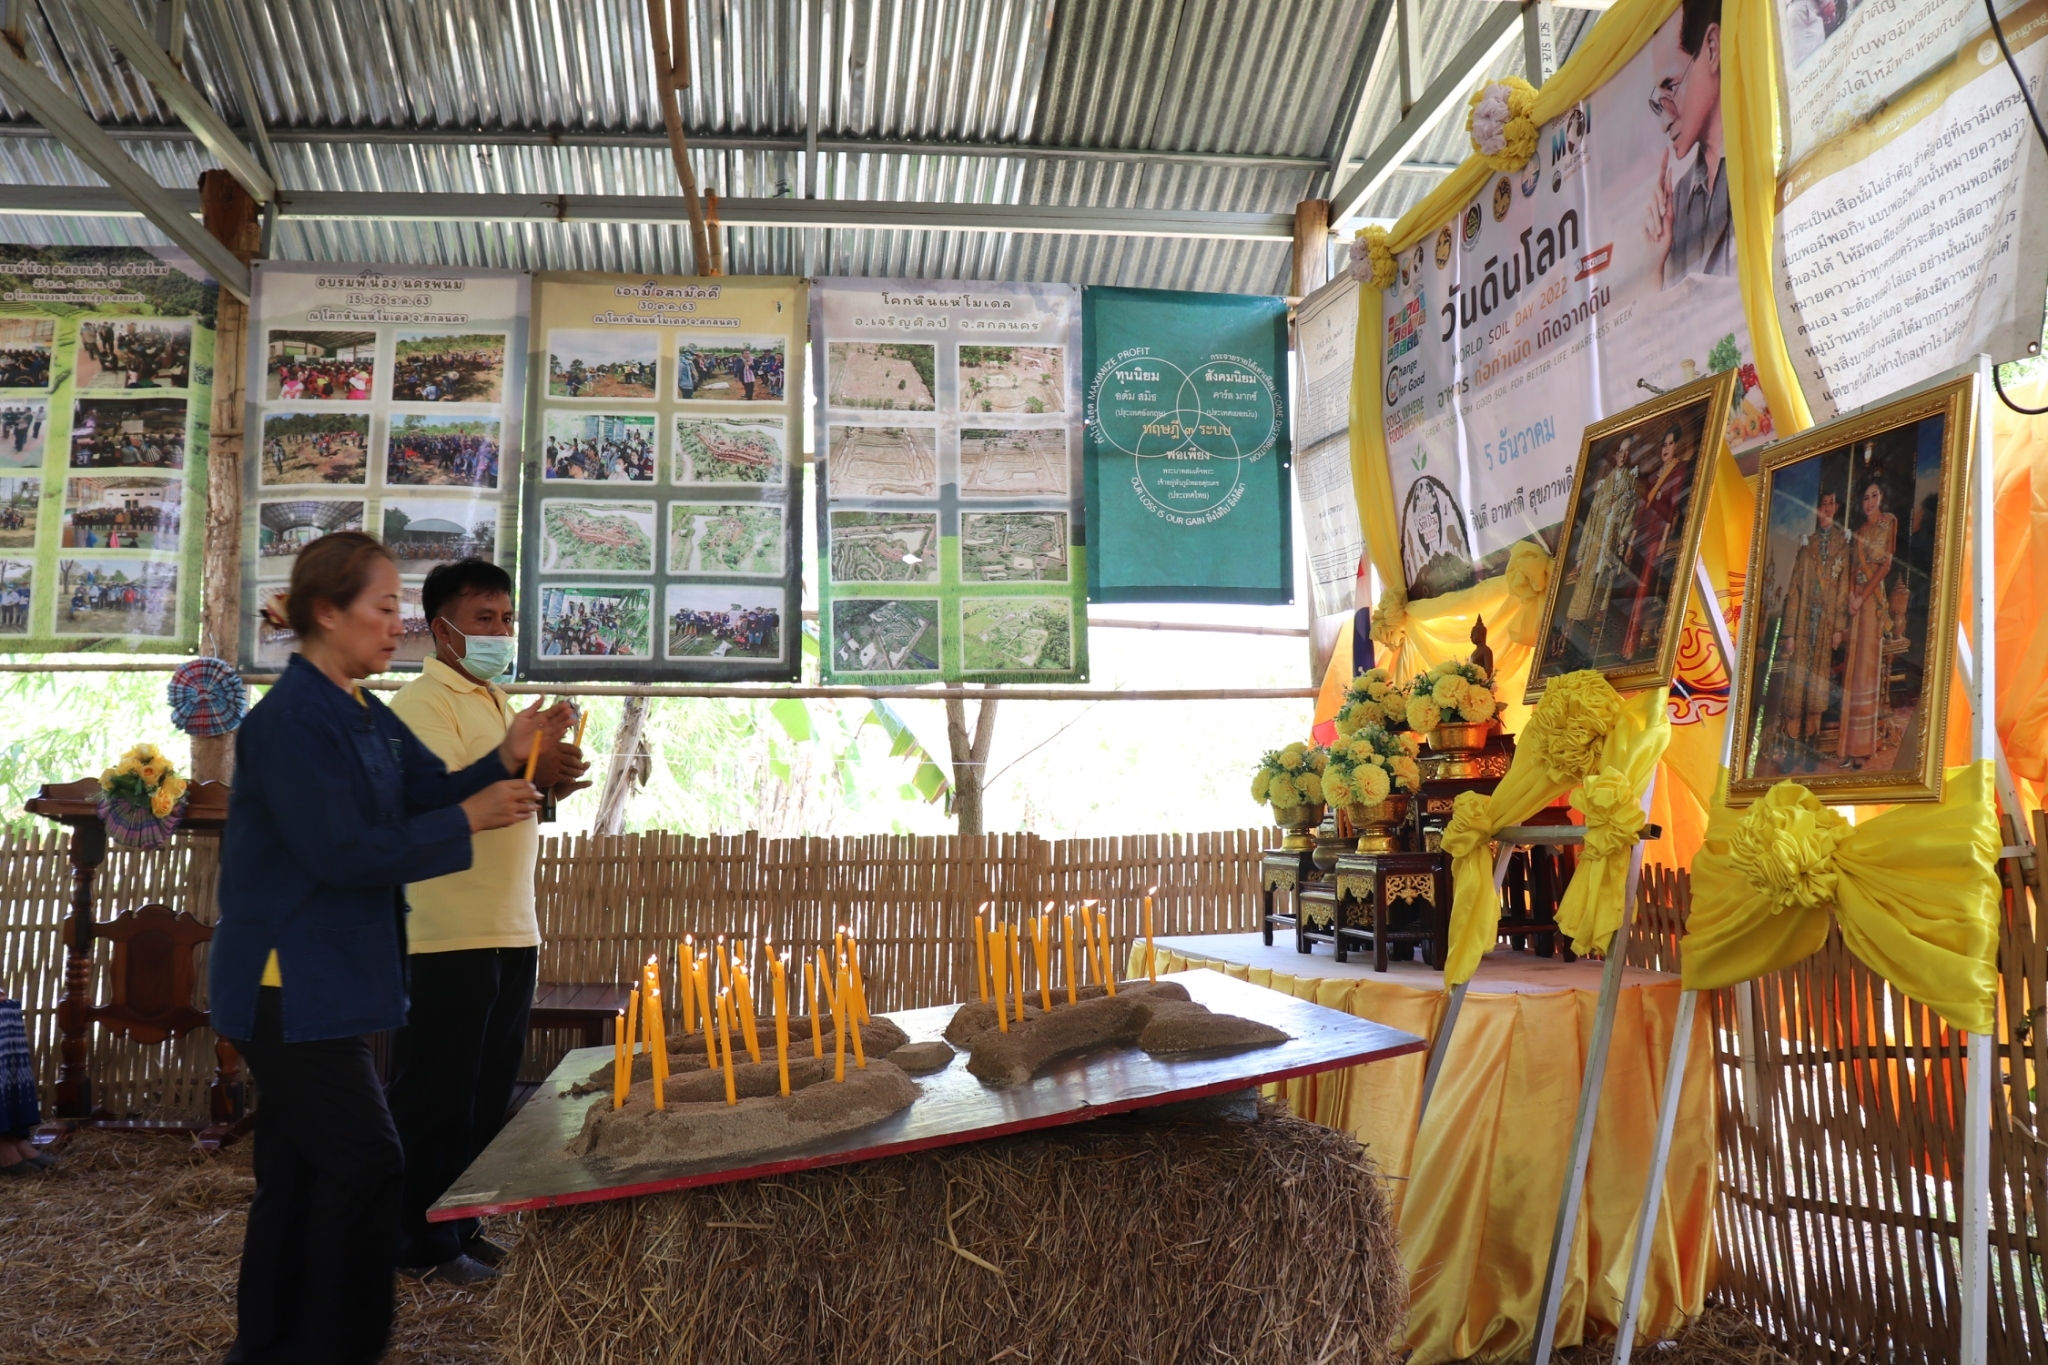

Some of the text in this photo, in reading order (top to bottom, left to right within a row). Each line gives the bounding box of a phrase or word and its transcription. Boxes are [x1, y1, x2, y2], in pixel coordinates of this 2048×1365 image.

[1542, 42, 1553, 63] SIZE
[110, 261, 170, 275] จ.เชียงใหม่
[1441, 209, 1578, 343] วันดินโลก
[1784, 255, 1834, 291] ตัวเองได้
[317, 271, 463, 289] อบรมพี่น้อง นครพนม
[348, 295, 361, 304] 15
[373, 295, 387, 304] 26
[416, 296, 430, 305] 63
[640, 302, 653, 310] 30
[681, 303, 695, 311] 63
[881, 292, 1011, 308] โคกหินแห่โมเดล
[412, 315, 466, 323] จ.สกลนคร
[690, 318, 739, 327] จ.สกลนคร
[961, 320, 1039, 330] จ.สกลนคร
[1452, 277, 1568, 368] WORLD SOIL DAY 2022
[1797, 313, 1838, 336] ตนเอง
[1436, 284, 1611, 408] อาหาร ก่อกำเนิด เกิดจากดิน
[1088, 357, 1117, 400] MAXIMIZE
[1118, 347, 1151, 360] PROFIT
[1115, 367, 1159, 384] ทุนนิยม
[1205, 369, 1256, 383] สังคมนิยม
[1476, 395, 1492, 410] GOOD
[1494, 388, 1508, 402] SOIL
[1511, 379, 1524, 391] FOR
[1526, 362, 1551, 382] BETTER
[1553, 352, 1568, 366] LIFE
[1570, 325, 1611, 355] AWARENESS
[1399, 370, 1426, 398] for Good
[1115, 389, 1157, 401] อดัม สมิธ
[1401, 396, 1425, 420] WHERE
[1142, 420, 1180, 439] ทฤษฎี
[1199, 424, 1232, 436] ระบบ
[1388, 424, 1404, 445] FOOD
[1250, 421, 1284, 464] DISTRIBUTION
[1484, 415, 1556, 471] 5 ธันวาคม
[1167, 447, 1210, 460] พอเพียง
[1131, 477, 1142, 494] OUR
[1142, 494, 1157, 513] LOSS
[1157, 509, 1165, 518] IS
[1166, 514, 1184, 525] OUR
[1185, 517, 1205, 526] GAIN
[1168, 490, 1210, 500] (ประเทศไทย)
[1471, 464, 1574, 532] ดินดี อาหารดี สุขภาพดี
